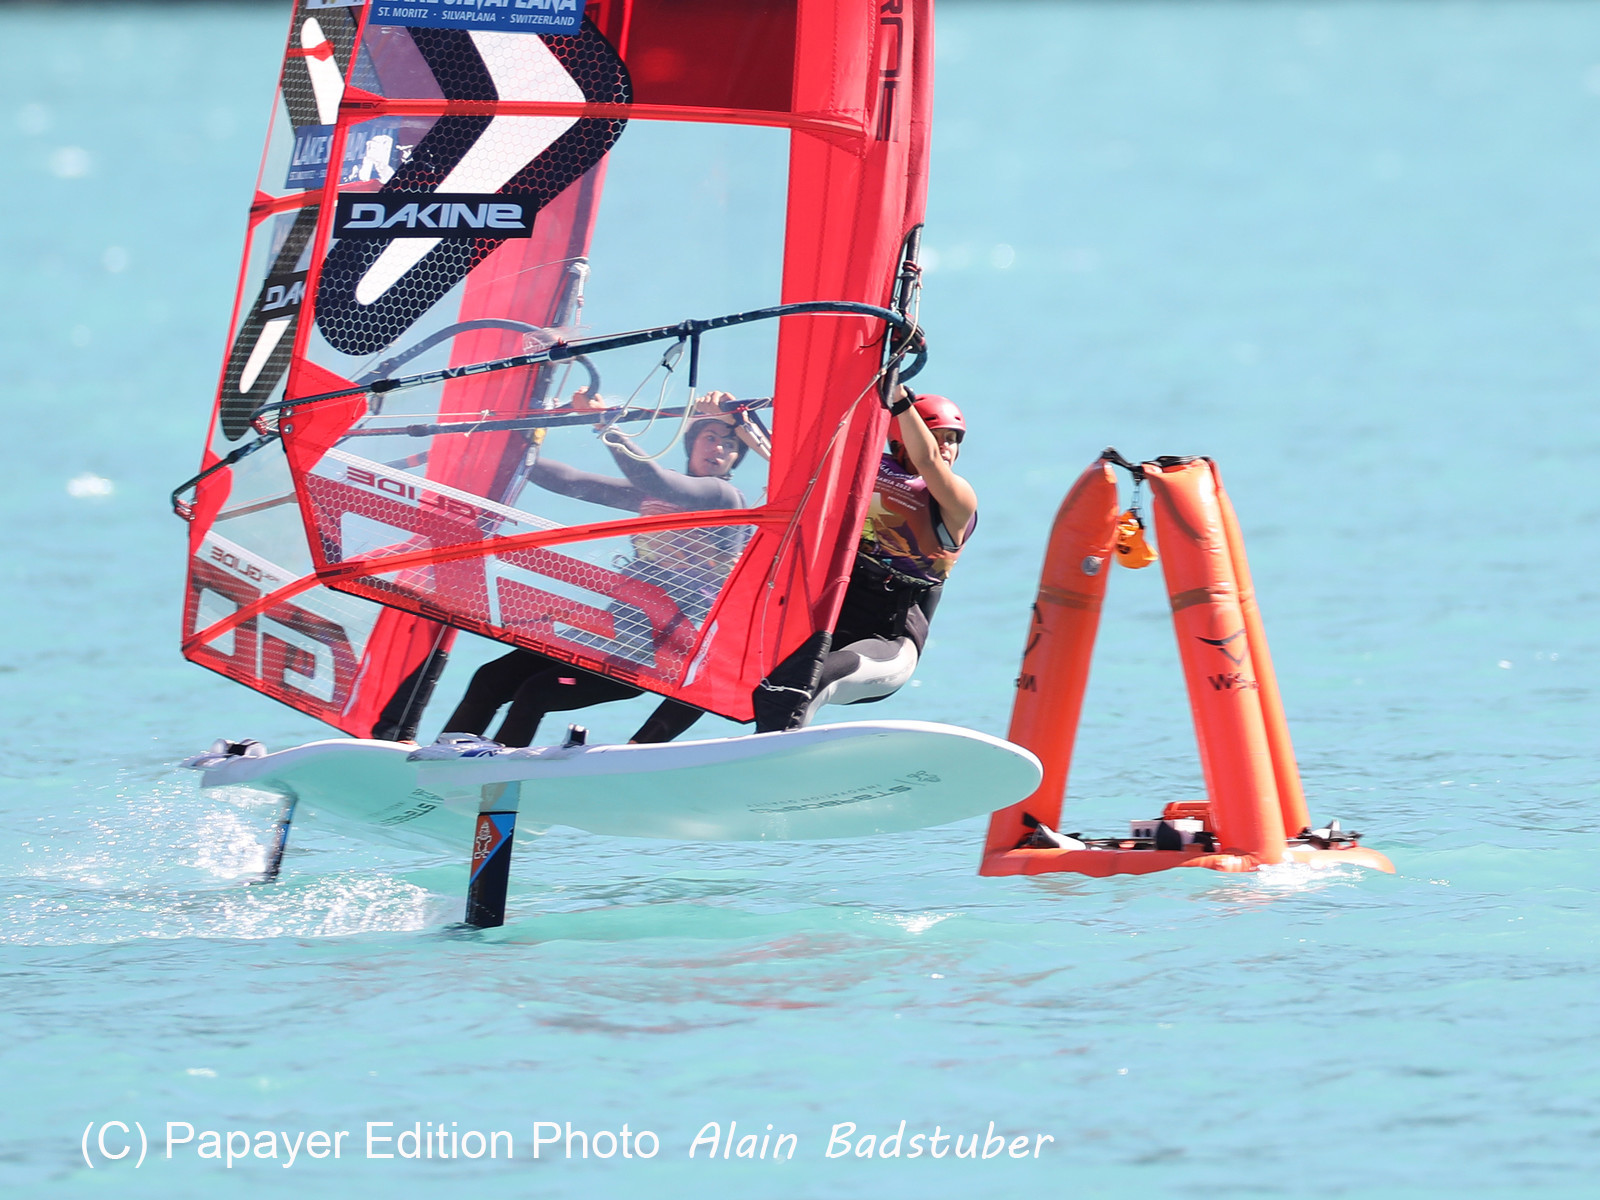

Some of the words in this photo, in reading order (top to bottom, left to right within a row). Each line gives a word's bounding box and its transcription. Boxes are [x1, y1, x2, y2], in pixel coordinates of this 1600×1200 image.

[378, 6, 390, 18] ST.
[391, 7, 429, 19] MORITZ
[441, 10, 497, 22] SILVAPLANA
[509, 13, 576, 26] SWITZERLAND
